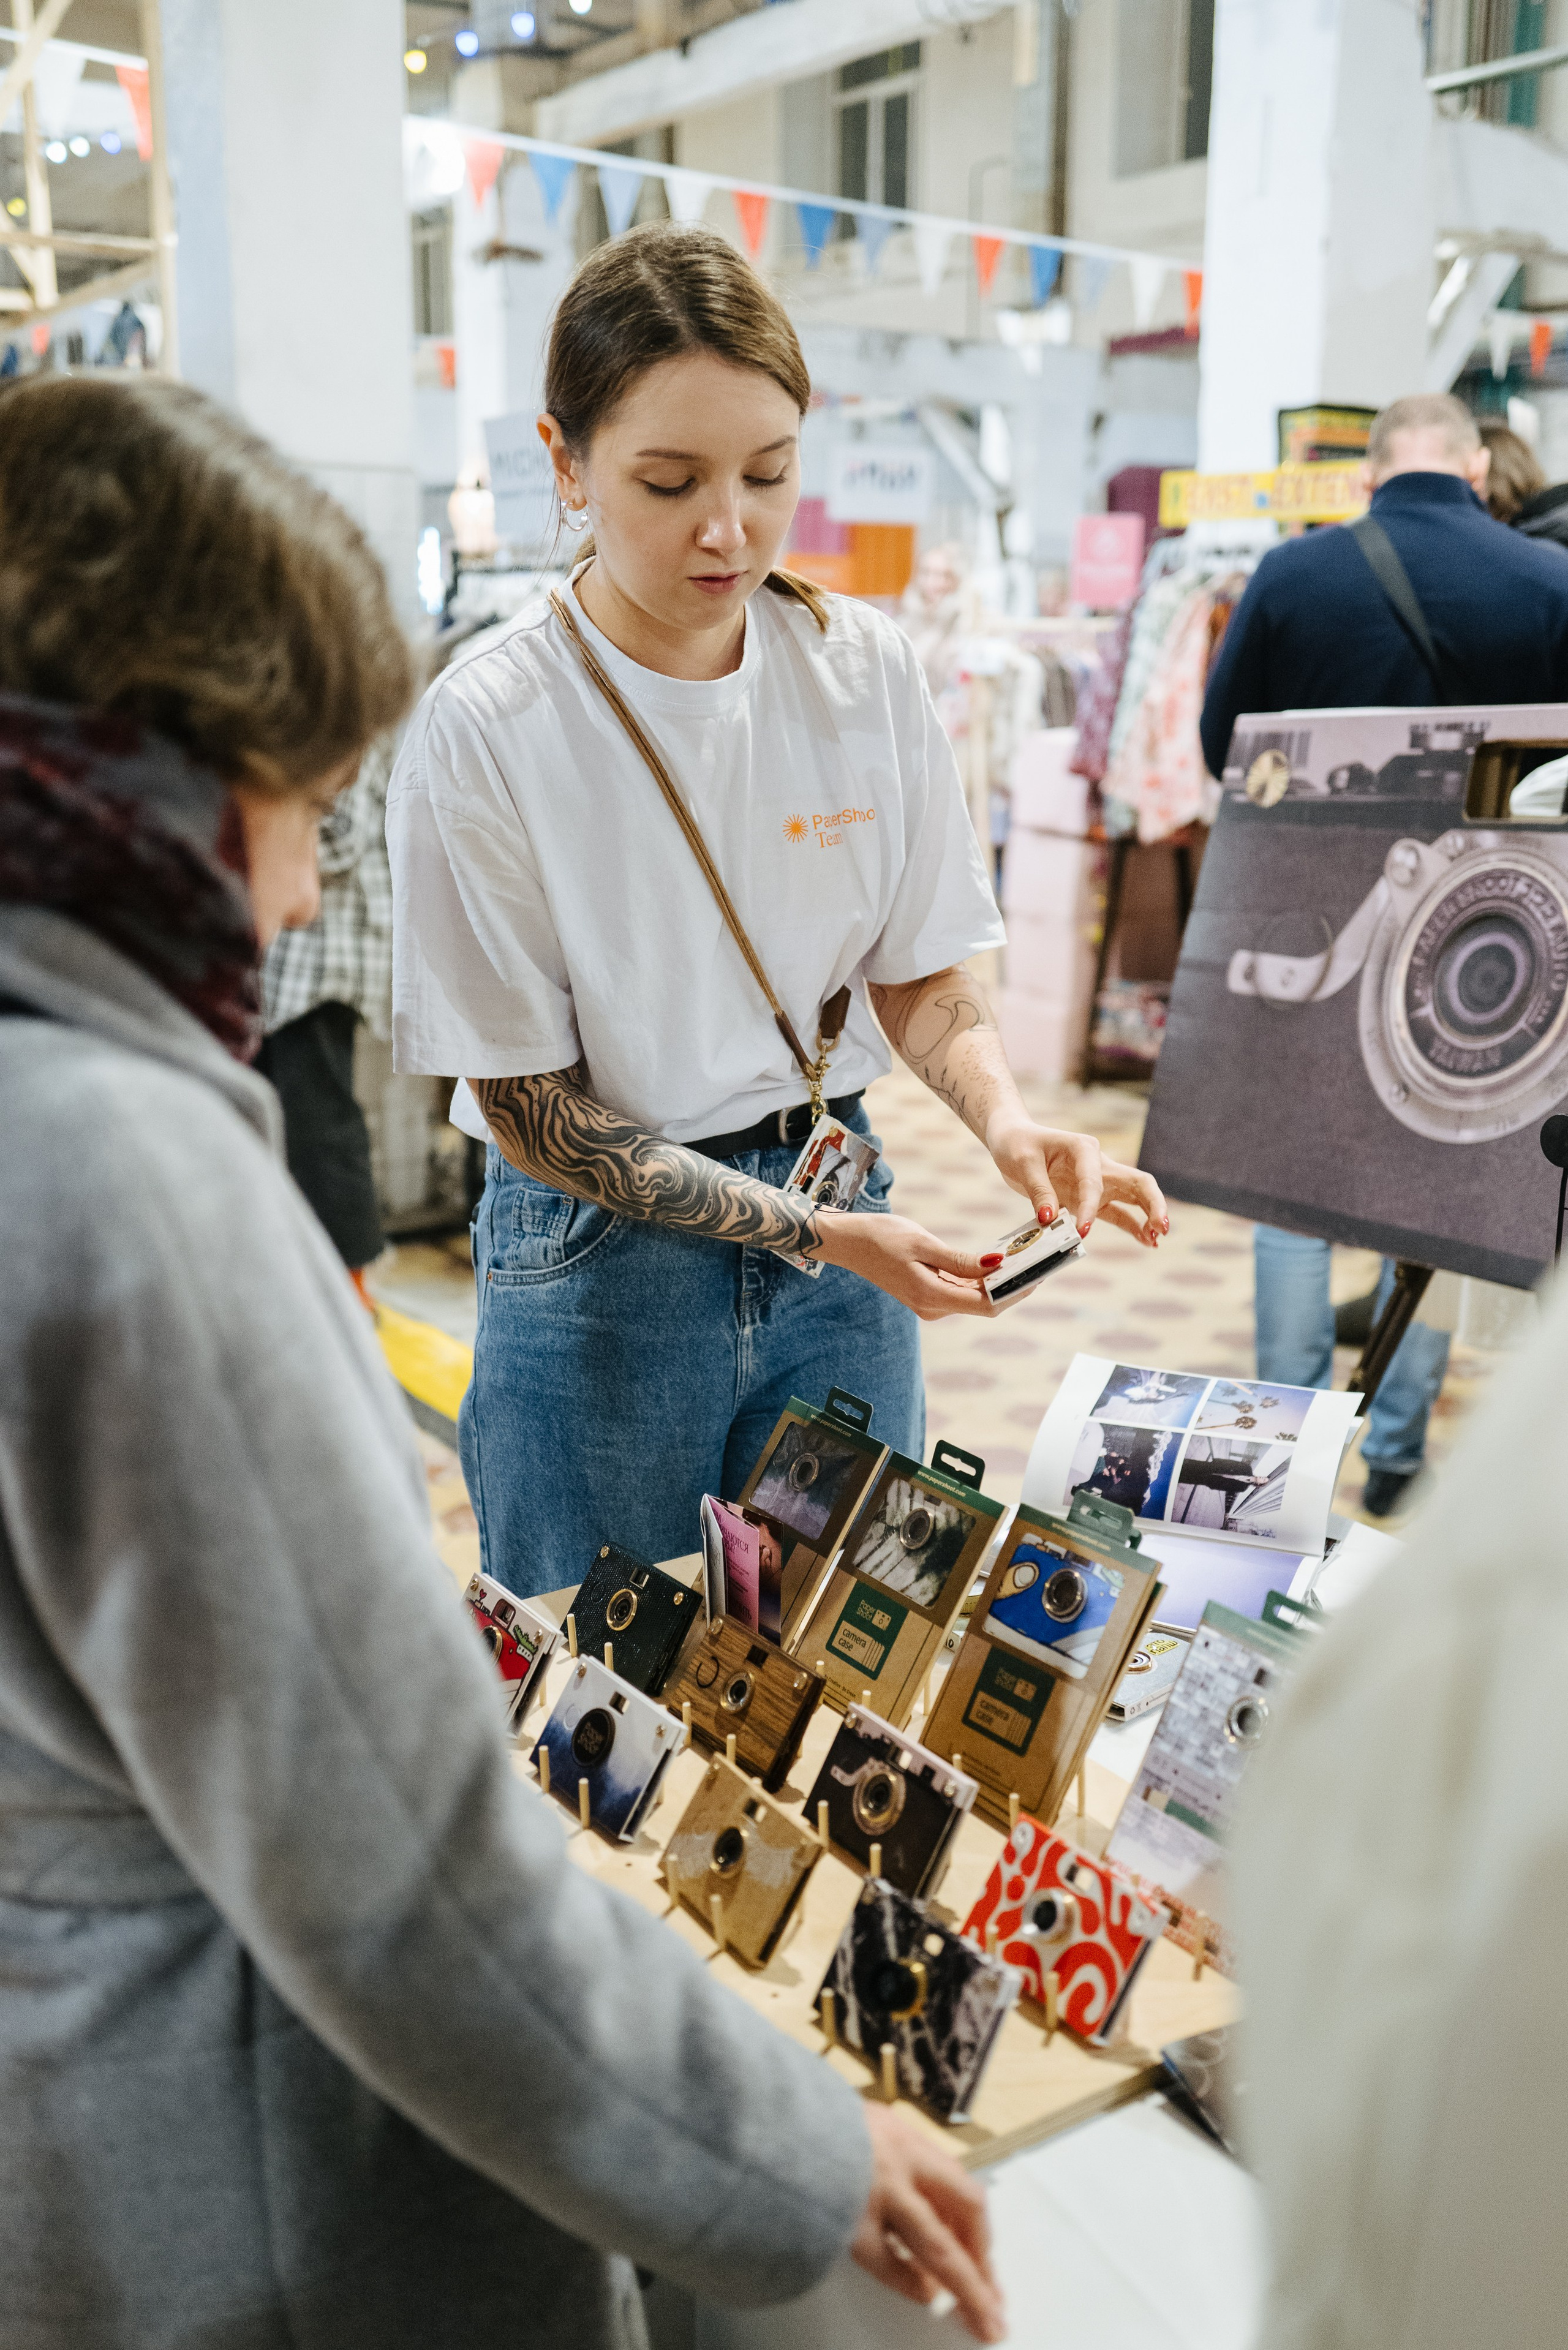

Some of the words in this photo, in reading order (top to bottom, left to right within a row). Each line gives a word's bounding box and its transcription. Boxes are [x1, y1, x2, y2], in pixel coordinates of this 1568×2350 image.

[815, 831, 843, 848] Team
[810, 1414, 852, 1437] www.papershoot.com
[918, 1471, 966, 1497] www.papershoot.com
[856, 1606, 873, 1621] Shoot
[859, 1599, 876, 1613] Paper
[838, 1638, 853, 1651] case
[842, 1629, 867, 1648] camera
